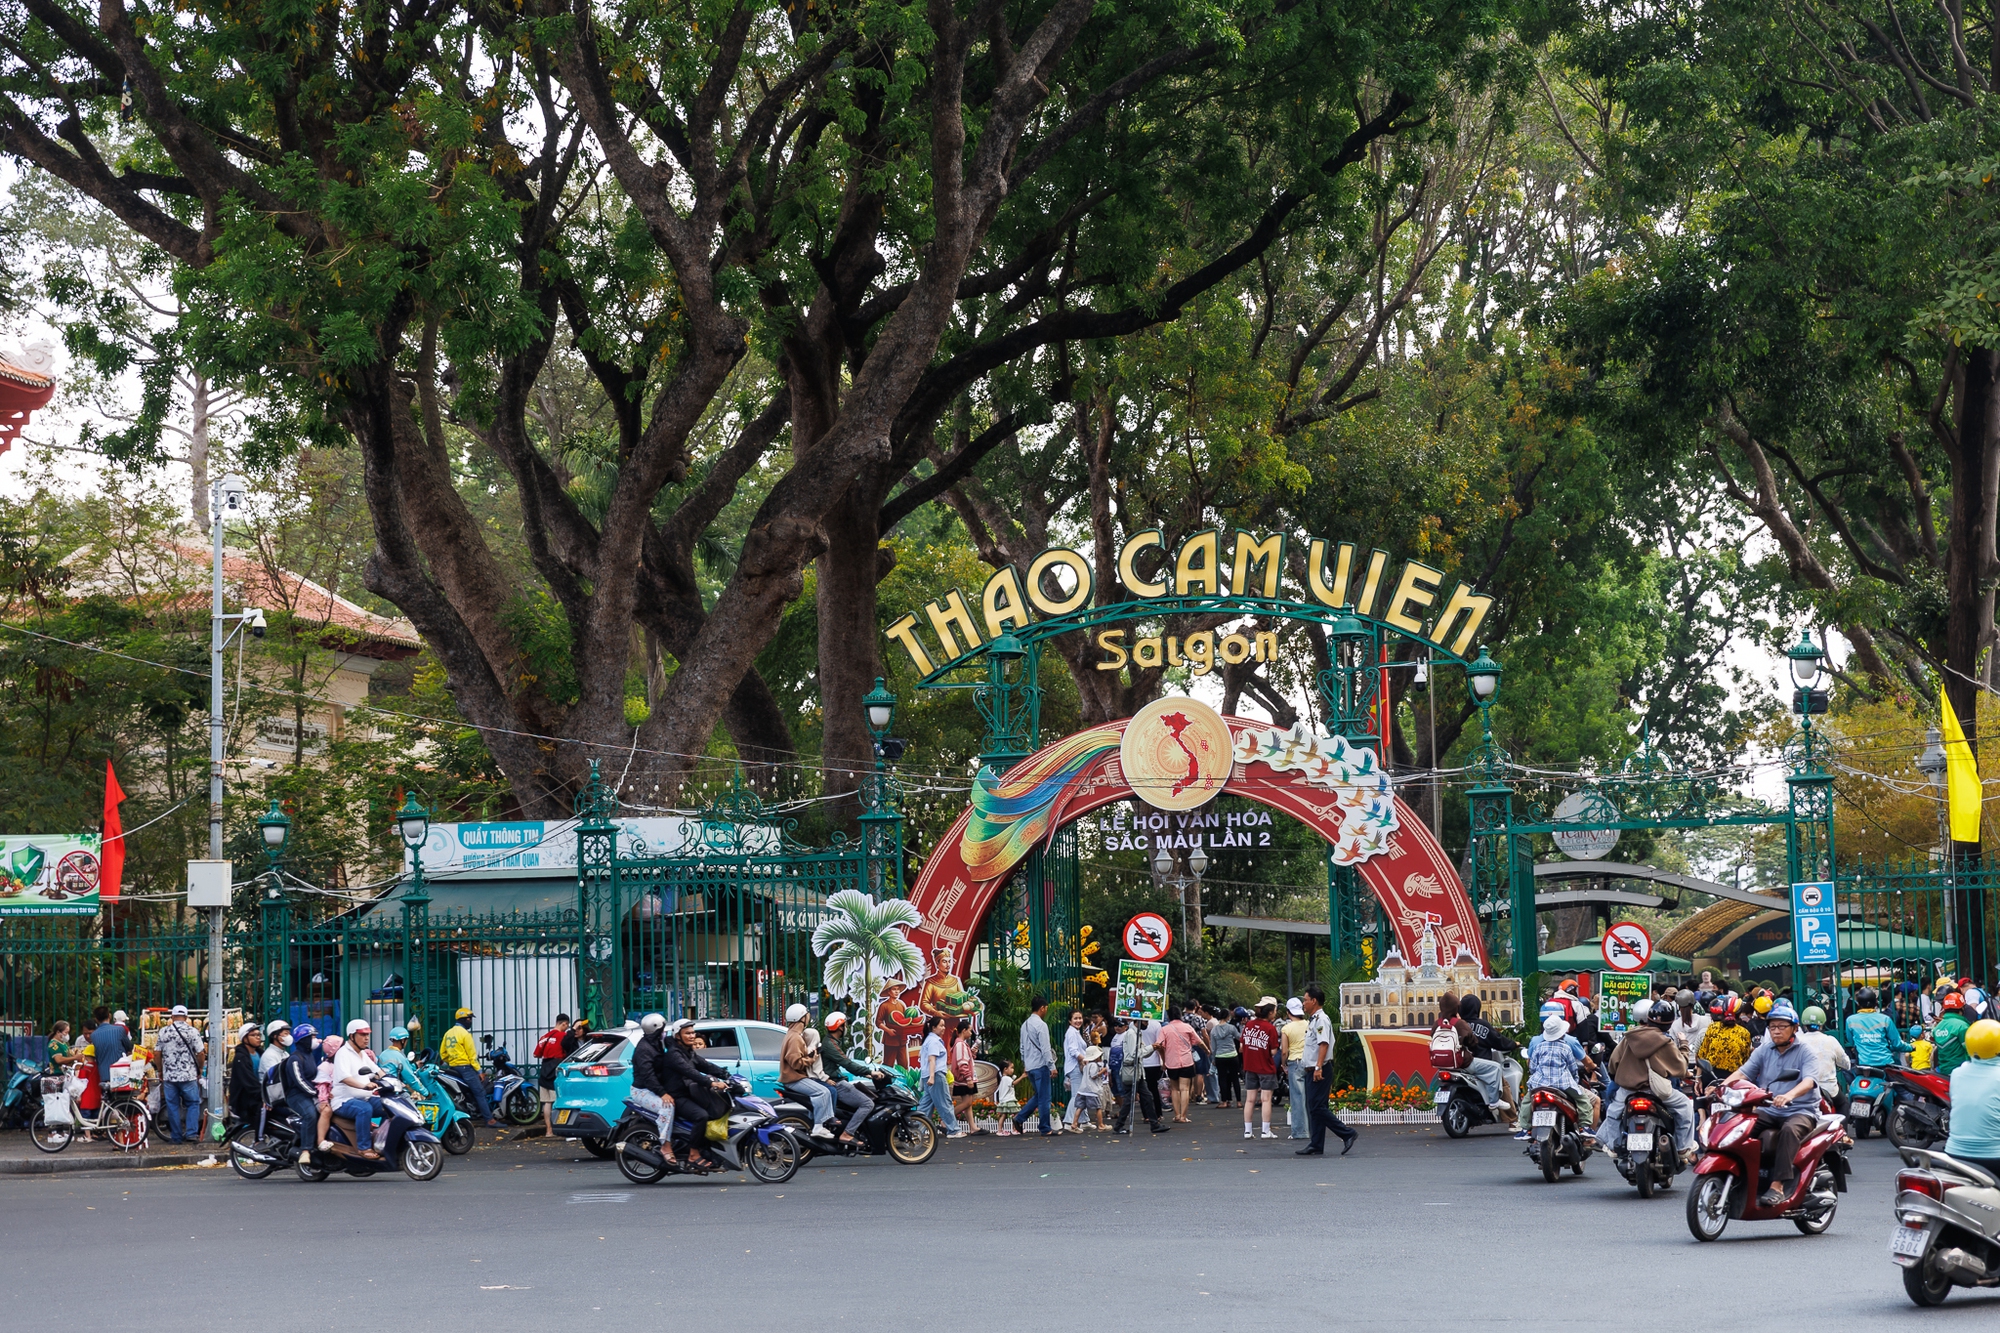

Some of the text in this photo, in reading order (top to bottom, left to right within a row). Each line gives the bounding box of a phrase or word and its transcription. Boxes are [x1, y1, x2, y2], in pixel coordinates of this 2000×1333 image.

[883, 547, 1096, 677] THAO
[1117, 528, 1287, 598] CAM
[1097, 628, 1279, 676] Saigon
[1100, 808, 1272, 833] LỄ HỘI VĂN HÓA
[490, 827, 521, 844] THÔNG
[523, 830, 539, 842] TIN
[1105, 827, 1271, 851] SẮC MÀU LẦN 2
[522, 852, 540, 868] QUAN
[1801, 917, 1820, 943] P
[1147, 970, 1153, 978] Ô
[1154, 970, 1164, 978] TÔ
[1603, 980, 1617, 988] BÃI
[1630, 980, 1636, 988] Ô
[1637, 982, 1648, 990] TÔ
[1935, 1028, 1949, 1038] Grab
[1892, 1239, 1919, 1254] 5604
